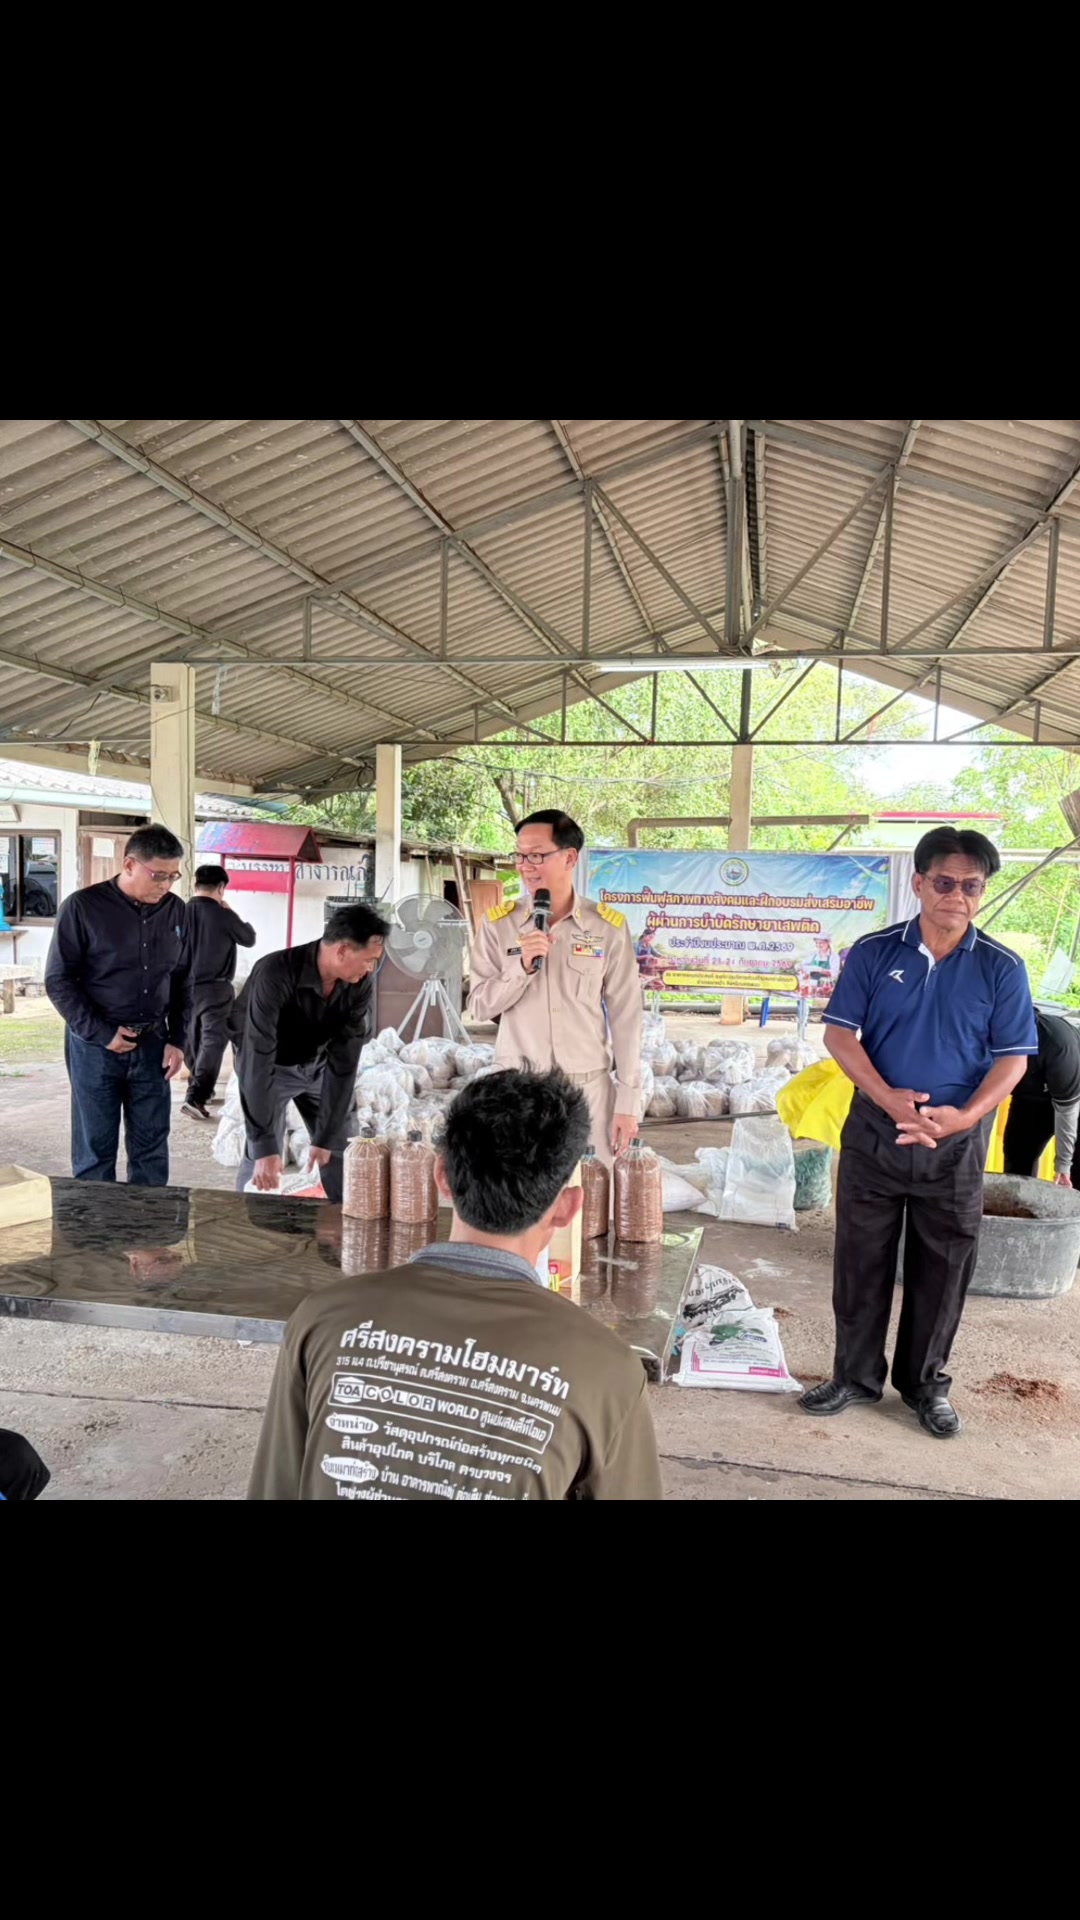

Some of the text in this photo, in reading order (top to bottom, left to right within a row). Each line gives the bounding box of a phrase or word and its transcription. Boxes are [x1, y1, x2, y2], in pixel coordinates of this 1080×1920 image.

[600, 886, 875, 911] โครงการฟื้นฟูสภาพทางสังคมและฝึกอบรมส่งเสริมอาชีพ
[646, 911, 820, 933] ผู้ผ่านการบำบัดรักษายาเสพติด
[668, 936, 794, 953] ประจำปีงบประมาณ พ.ศ.2569
[340, 1320, 570, 1400] ศรีสงครามโฮมมาร์ท
[336, 1356, 350, 1366] 315
[470, 1376, 520, 1400] อ.ศรีสงคราม
[520, 1393, 562, 1417] จ.นครพนม
[336, 1383, 362, 1397] TOA
[364, 1386, 435, 1410] COLOR
[436, 1401, 479, 1421] WORLD
[329, 1412, 542, 1474] จำหน่าย วัสดุอุปกรณ์ก่อสร้างทุกชนิด
[341, 1435, 512, 1484] สินค้าอุปโภค บริโภค ครบวงจร
[381, 1466, 399, 1486] บ้าน
[401, 1474, 457, 1499] อาคารพาณิชย์
